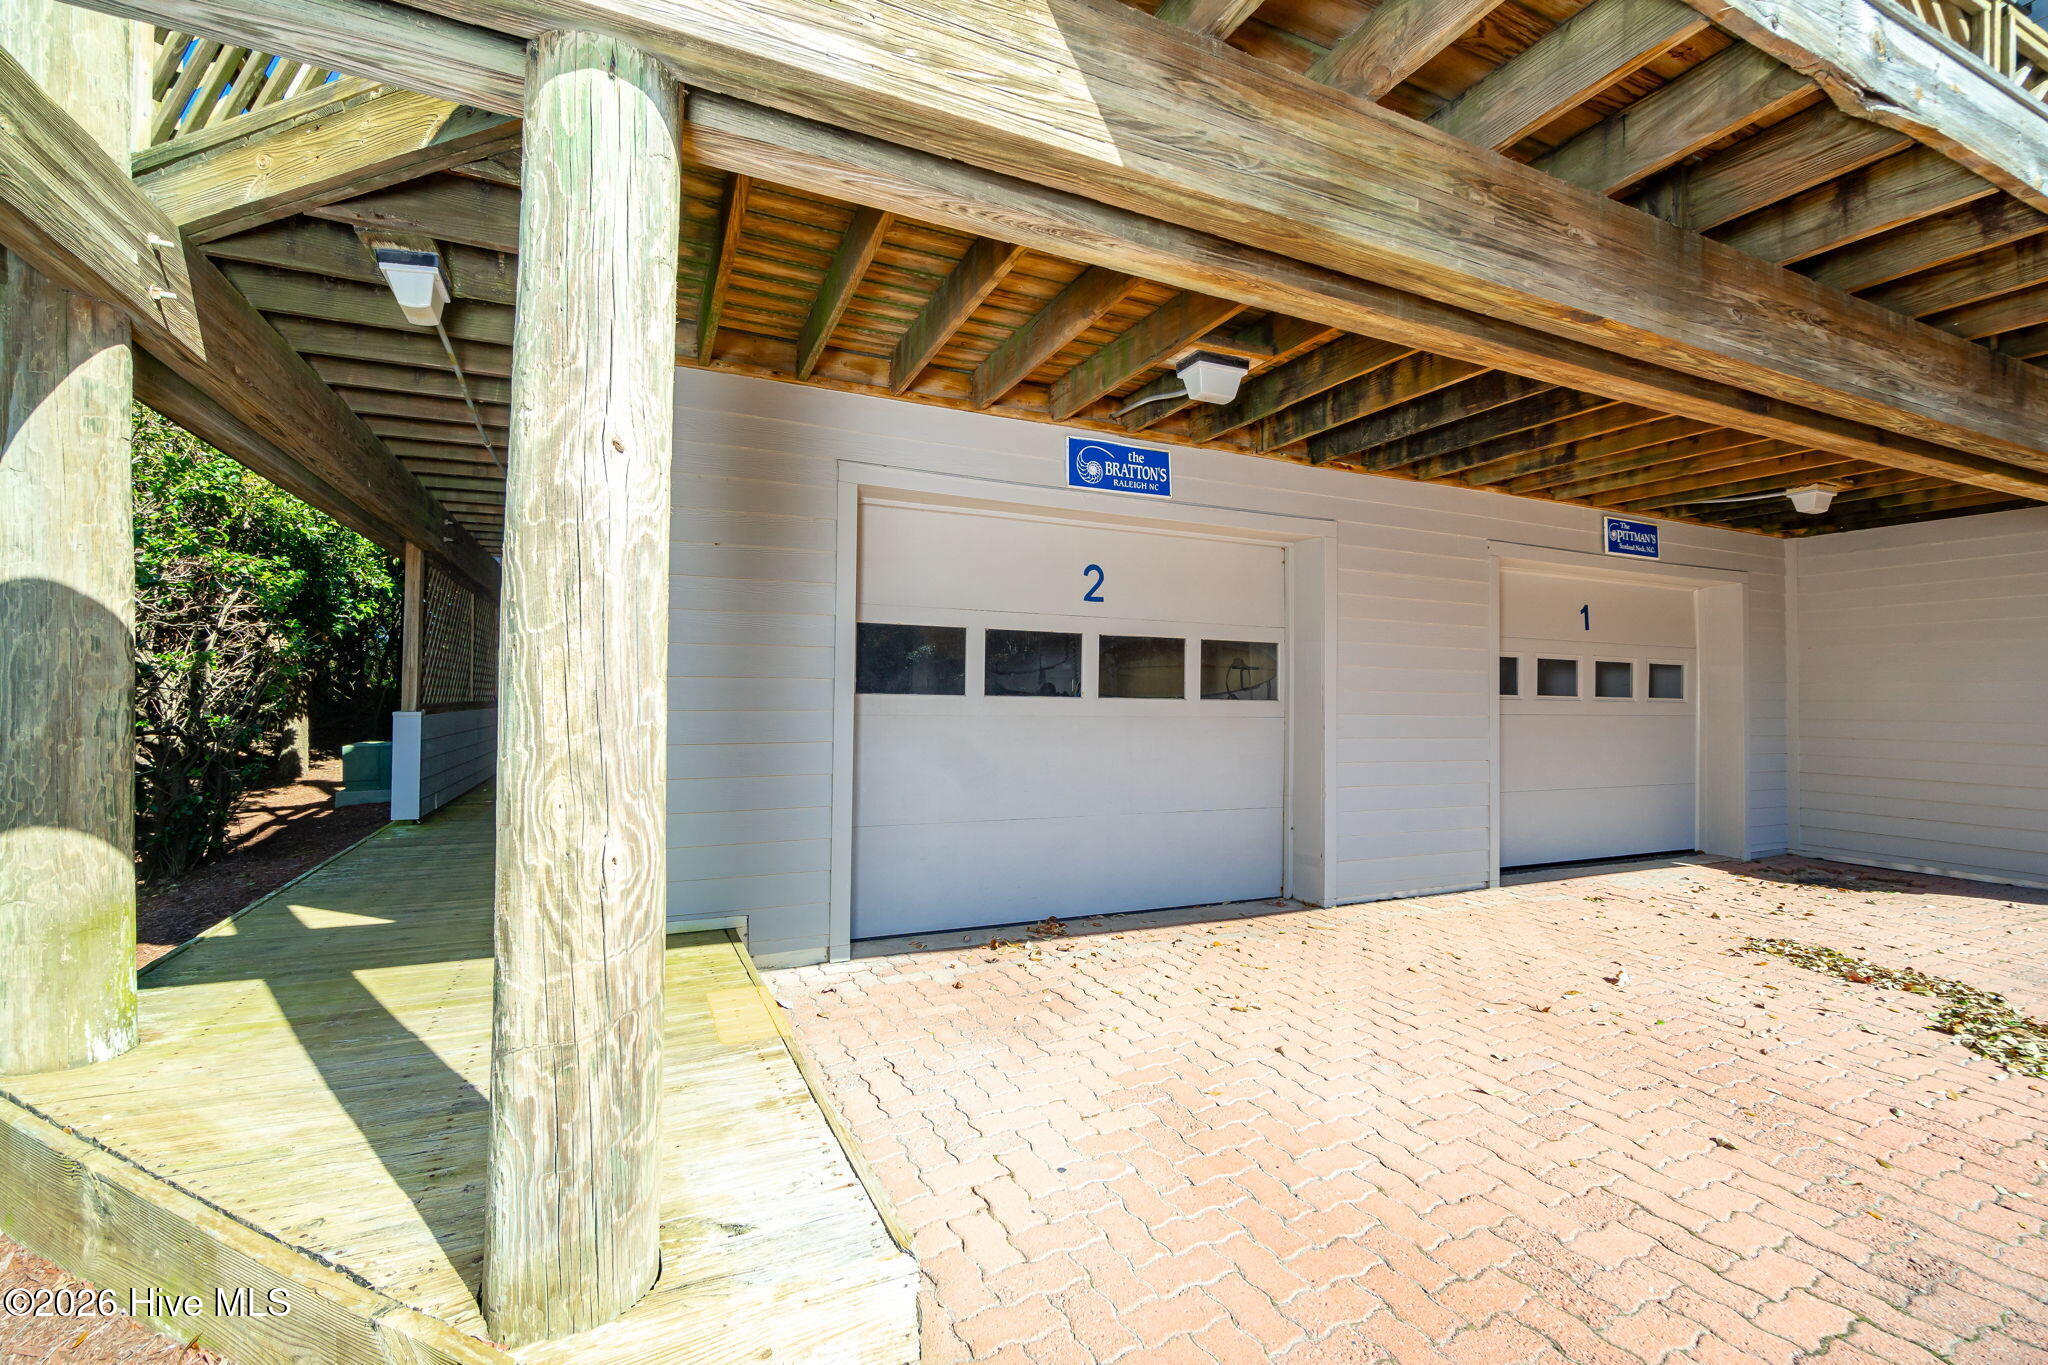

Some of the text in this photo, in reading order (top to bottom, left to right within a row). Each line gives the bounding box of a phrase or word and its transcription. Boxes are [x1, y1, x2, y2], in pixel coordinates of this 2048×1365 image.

[1128, 451, 1145, 463] the
[1105, 461, 1167, 482] BRATTON'S
[1113, 479, 1159, 491] RALEIGH NC
[1616, 530, 1656, 544] PITTMAN'S
[1084, 564, 1104, 602] 2
[1580, 604, 1590, 631] 1
